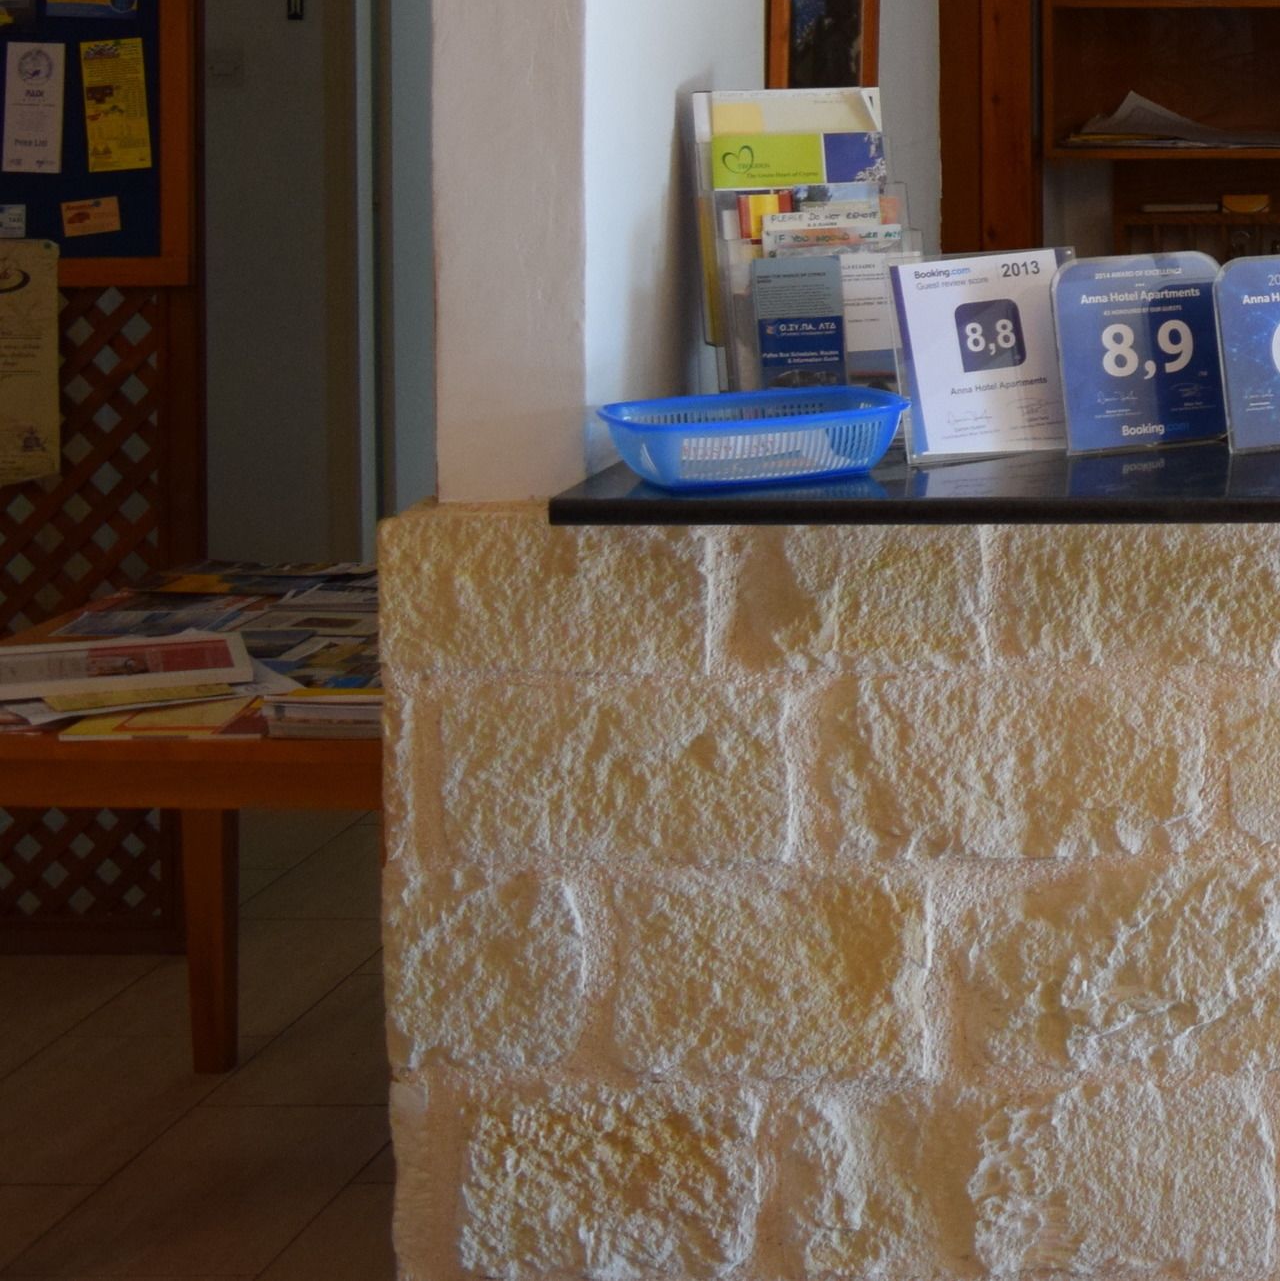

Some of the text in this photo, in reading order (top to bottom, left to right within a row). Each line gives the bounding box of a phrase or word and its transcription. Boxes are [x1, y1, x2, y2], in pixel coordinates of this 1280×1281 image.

[914, 267, 971, 279] Booking.com
[1001, 260, 1040, 278] 2013
[916, 276, 988, 290] Guest review score
[1081, 287, 1200, 304] Anna Hotel Apartments
[1242, 294, 1270, 305] Anna
[965, 319, 1016, 355] 8,8
[1102, 319, 1194, 380] 8,9
[950, 376, 1048, 395] Anna Hotel Apartments
[1122, 421, 1189, 436] Booking.com
